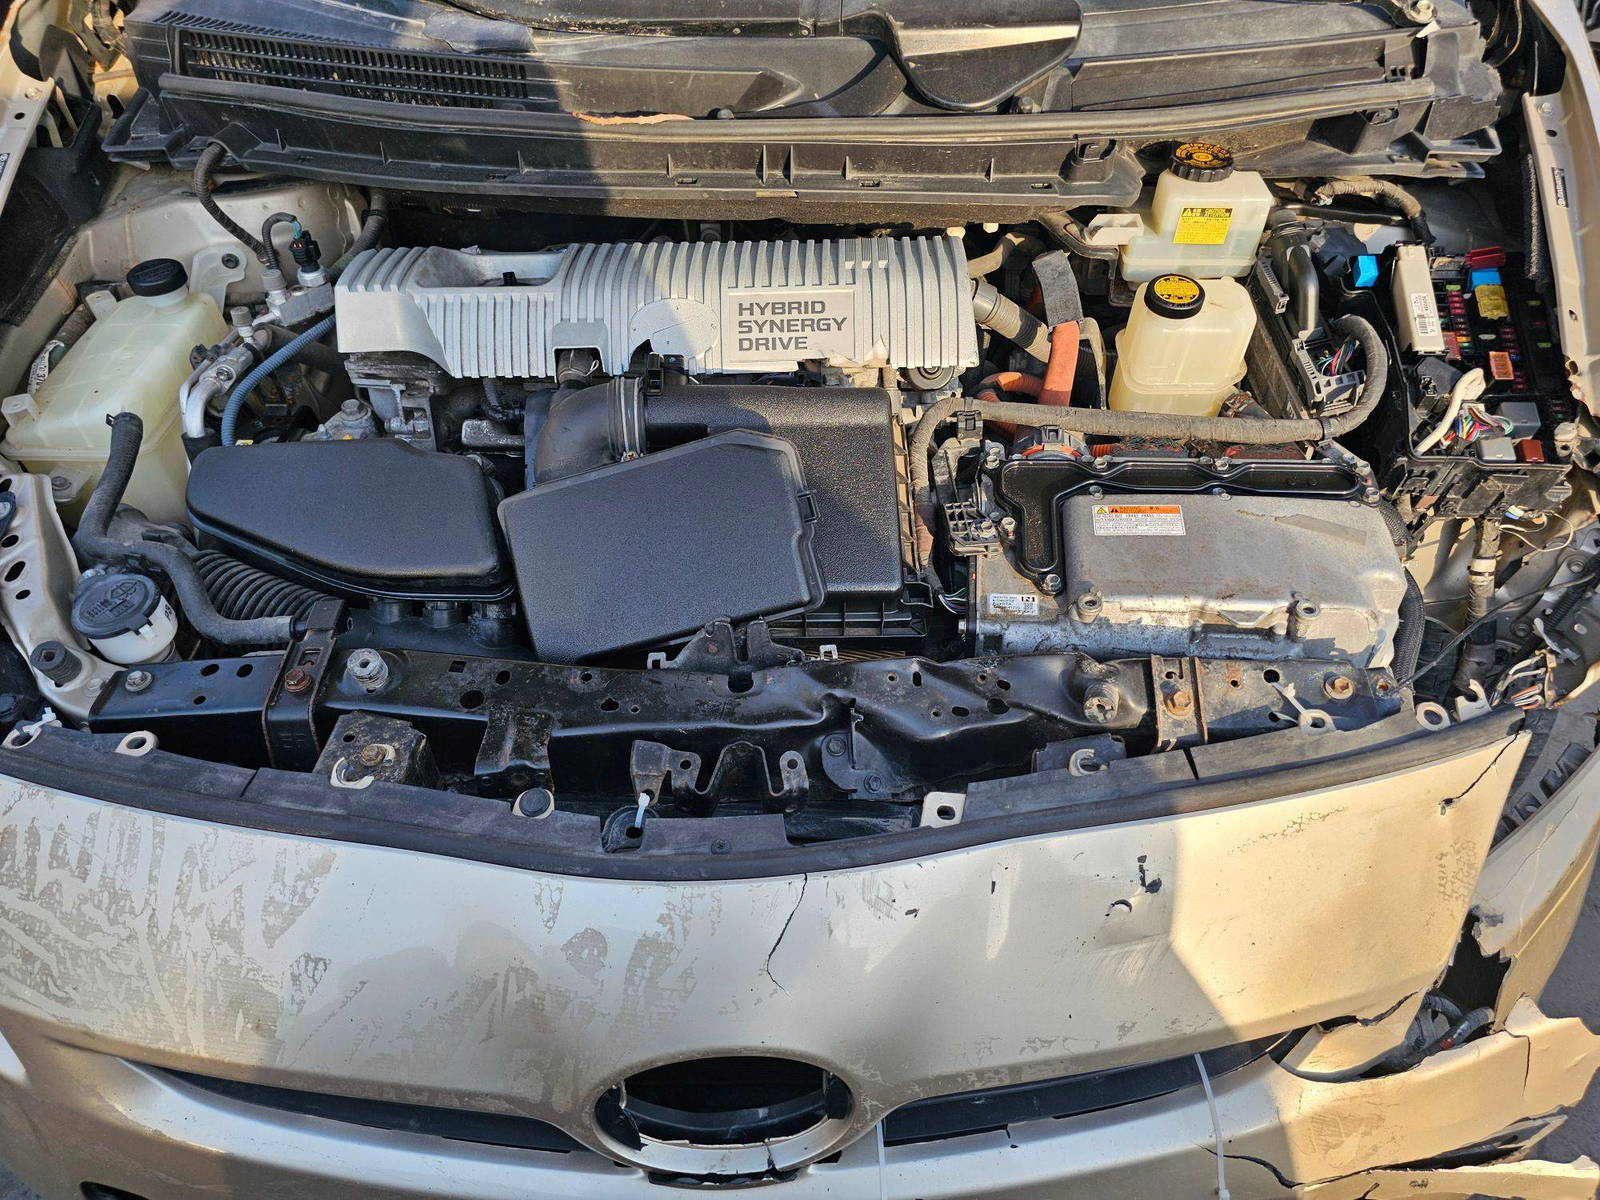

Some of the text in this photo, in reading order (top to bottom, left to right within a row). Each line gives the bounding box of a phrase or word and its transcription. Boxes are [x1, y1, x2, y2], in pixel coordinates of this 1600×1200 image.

[738, 300, 825, 316] HYBRID
[738, 317, 847, 334] SYNERGY
[738, 336, 808, 352] DRIVE
